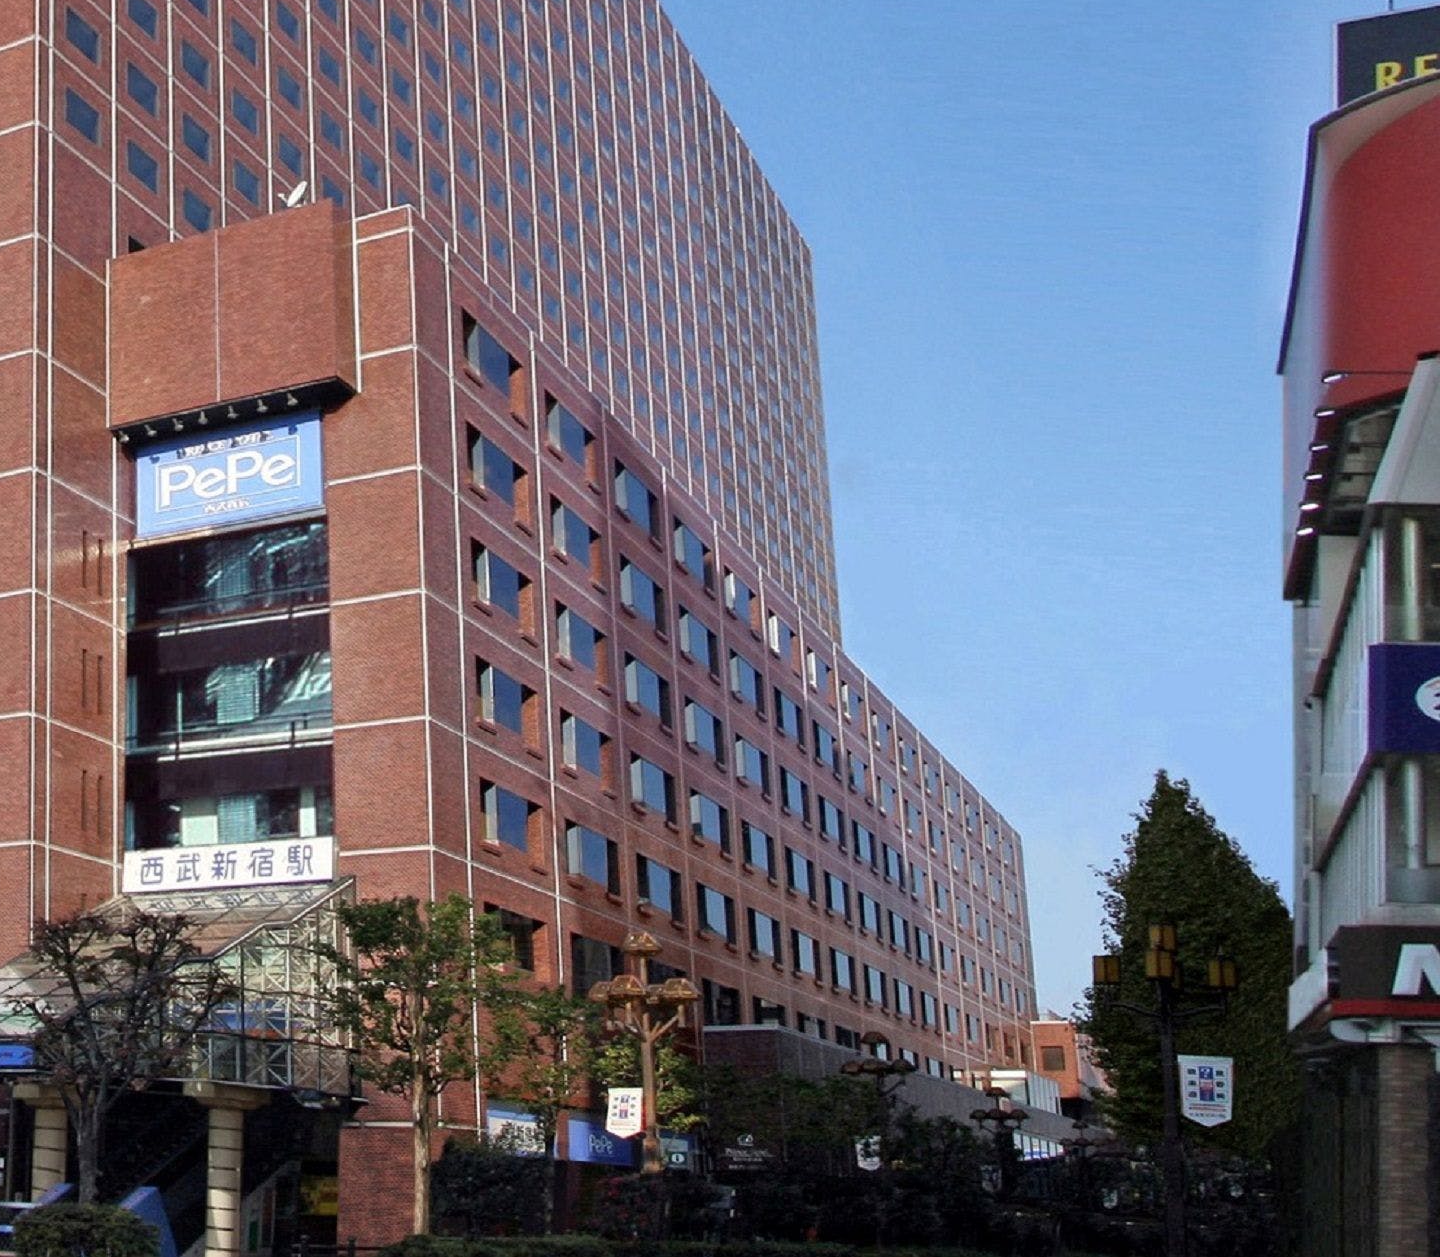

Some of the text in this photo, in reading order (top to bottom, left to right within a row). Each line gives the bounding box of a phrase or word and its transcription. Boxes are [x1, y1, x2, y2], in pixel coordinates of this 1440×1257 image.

[160, 450, 296, 508] PePe
[140, 845, 313, 886] 西武新宿駅
